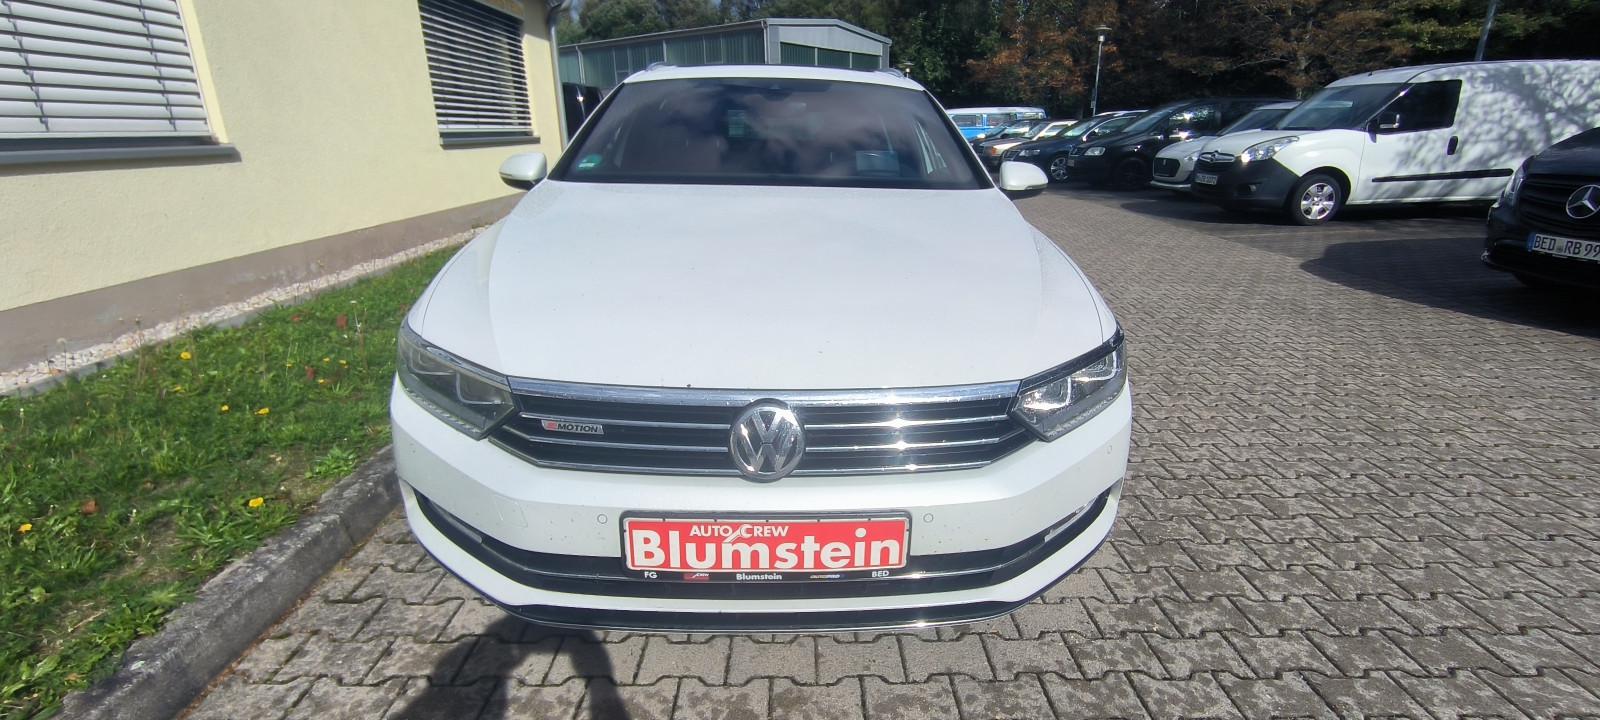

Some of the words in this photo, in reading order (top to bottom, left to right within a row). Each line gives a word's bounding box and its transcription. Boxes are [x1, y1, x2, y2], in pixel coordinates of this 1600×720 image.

[1533, 235, 1557, 251] BED
[1563, 240, 1582, 255] RB
[545, 421, 599, 432] MOTION
[689, 525, 732, 537] AUTO
[739, 524, 789, 538] CREW
[632, 527, 900, 569] Blumstein
[644, 571, 658, 579] FG
[736, 572, 783, 580] Blumstein
[871, 570, 889, 578] BED
